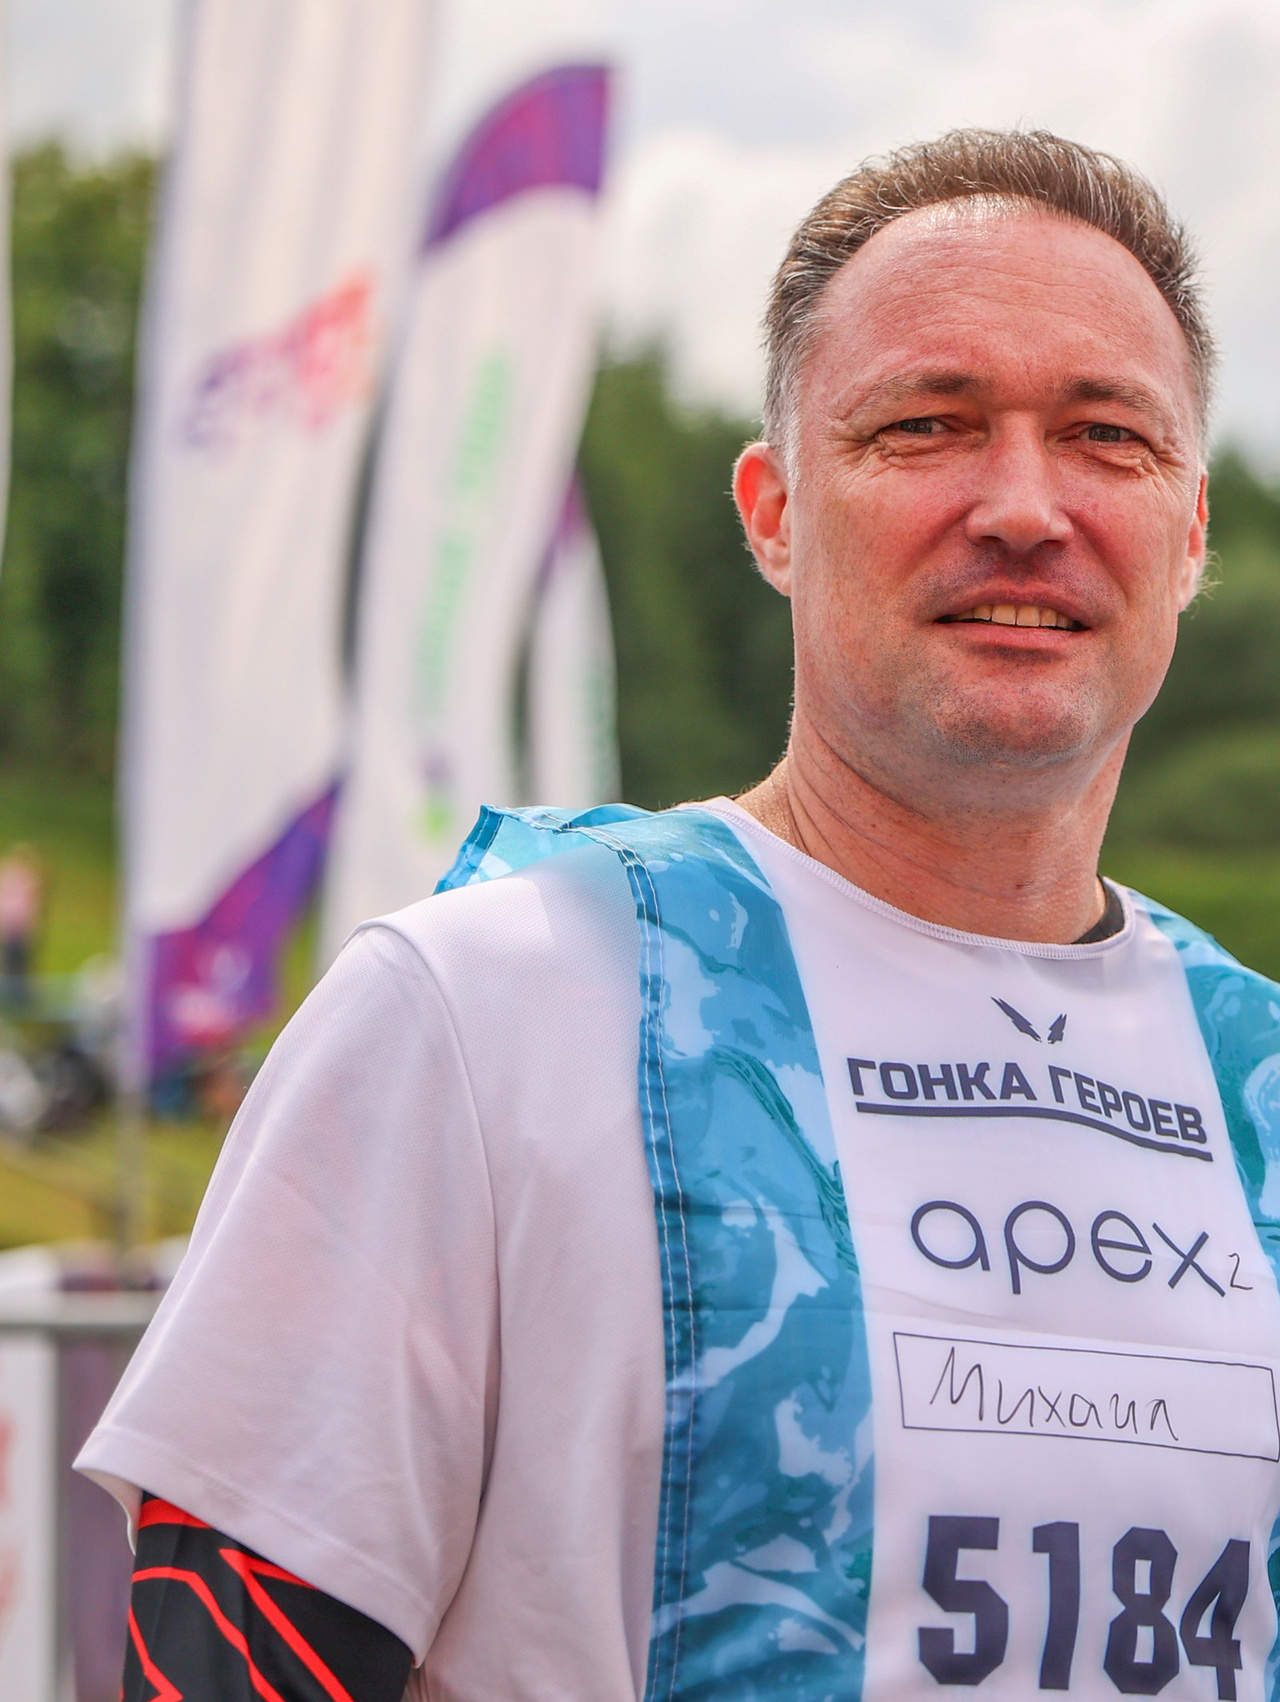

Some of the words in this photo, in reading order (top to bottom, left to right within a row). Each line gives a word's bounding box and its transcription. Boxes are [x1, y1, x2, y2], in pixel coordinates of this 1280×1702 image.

[847, 1057, 1037, 1101] ГОНКА
[1047, 1065, 1208, 1145] ГЕРОЕВ
[910, 1200, 1226, 1297] apex
[929, 1345, 1179, 1442] Михаил
[918, 1514, 1252, 1701] 5184
